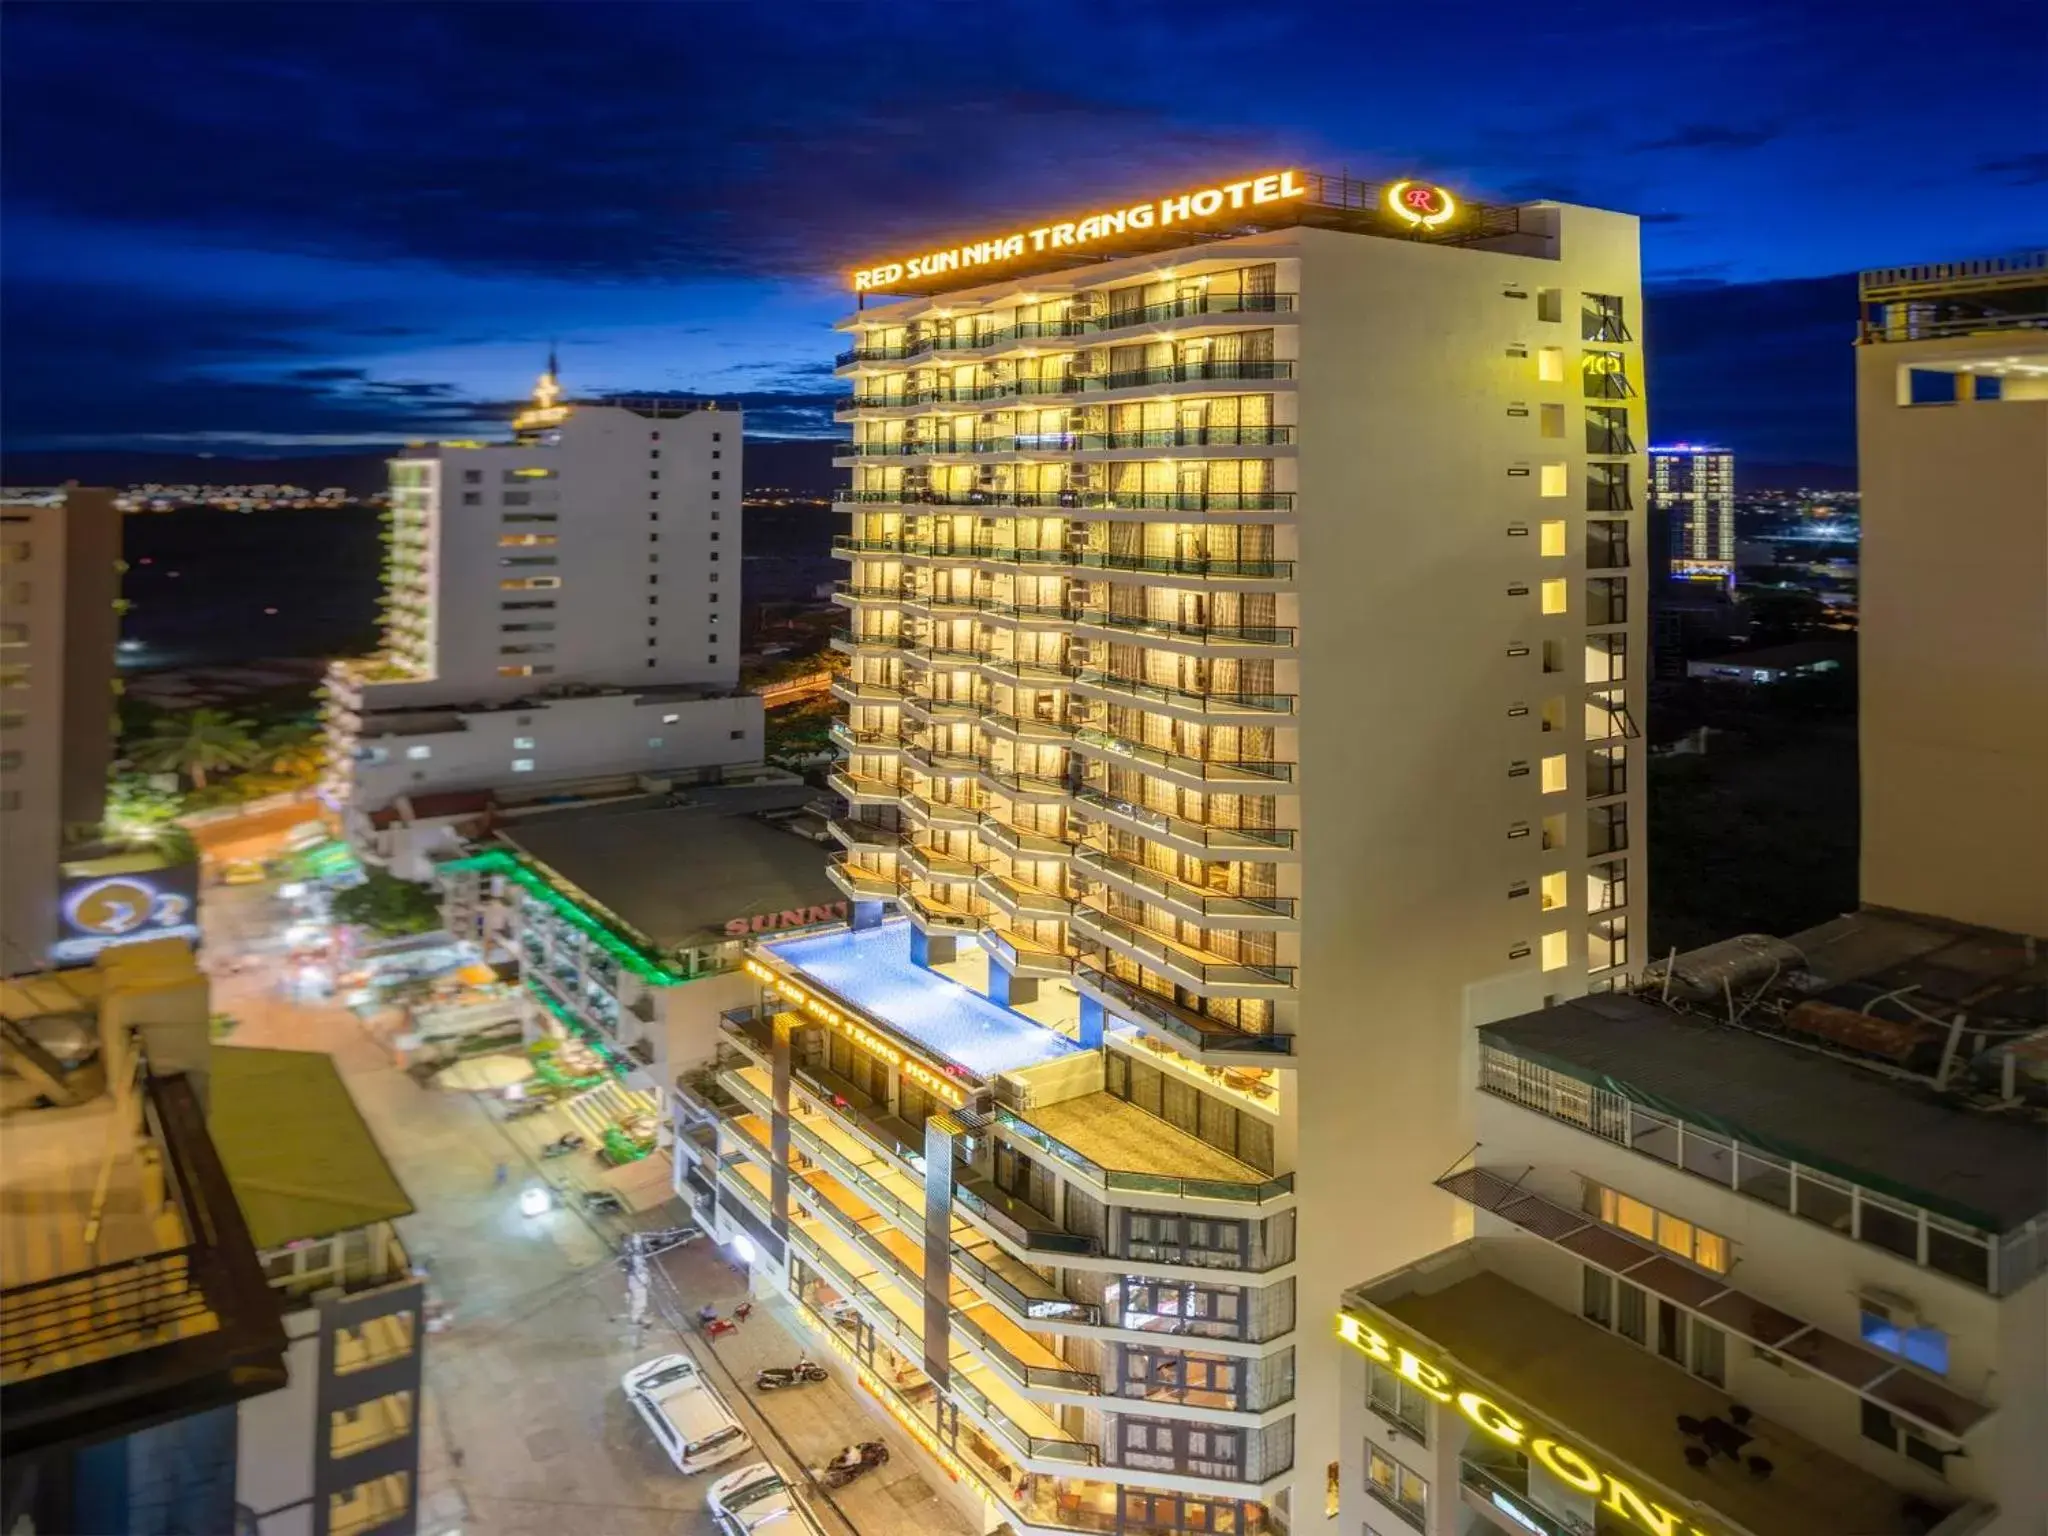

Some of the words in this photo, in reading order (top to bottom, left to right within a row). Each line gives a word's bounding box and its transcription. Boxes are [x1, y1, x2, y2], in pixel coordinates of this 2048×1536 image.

[854, 265, 902, 291] RED
[906, 250, 958, 277] SUN
[962, 234, 1024, 265] NHA
[1029, 205, 1155, 251] TRANG
[1161, 170, 1304, 224] HOTEL
[1406, 190, 1439, 213] R
[844, 1021, 900, 1064] TRANG
[905, 1060, 963, 1105] HOTEL
[1337, 1311, 1706, 1536] BEGON
